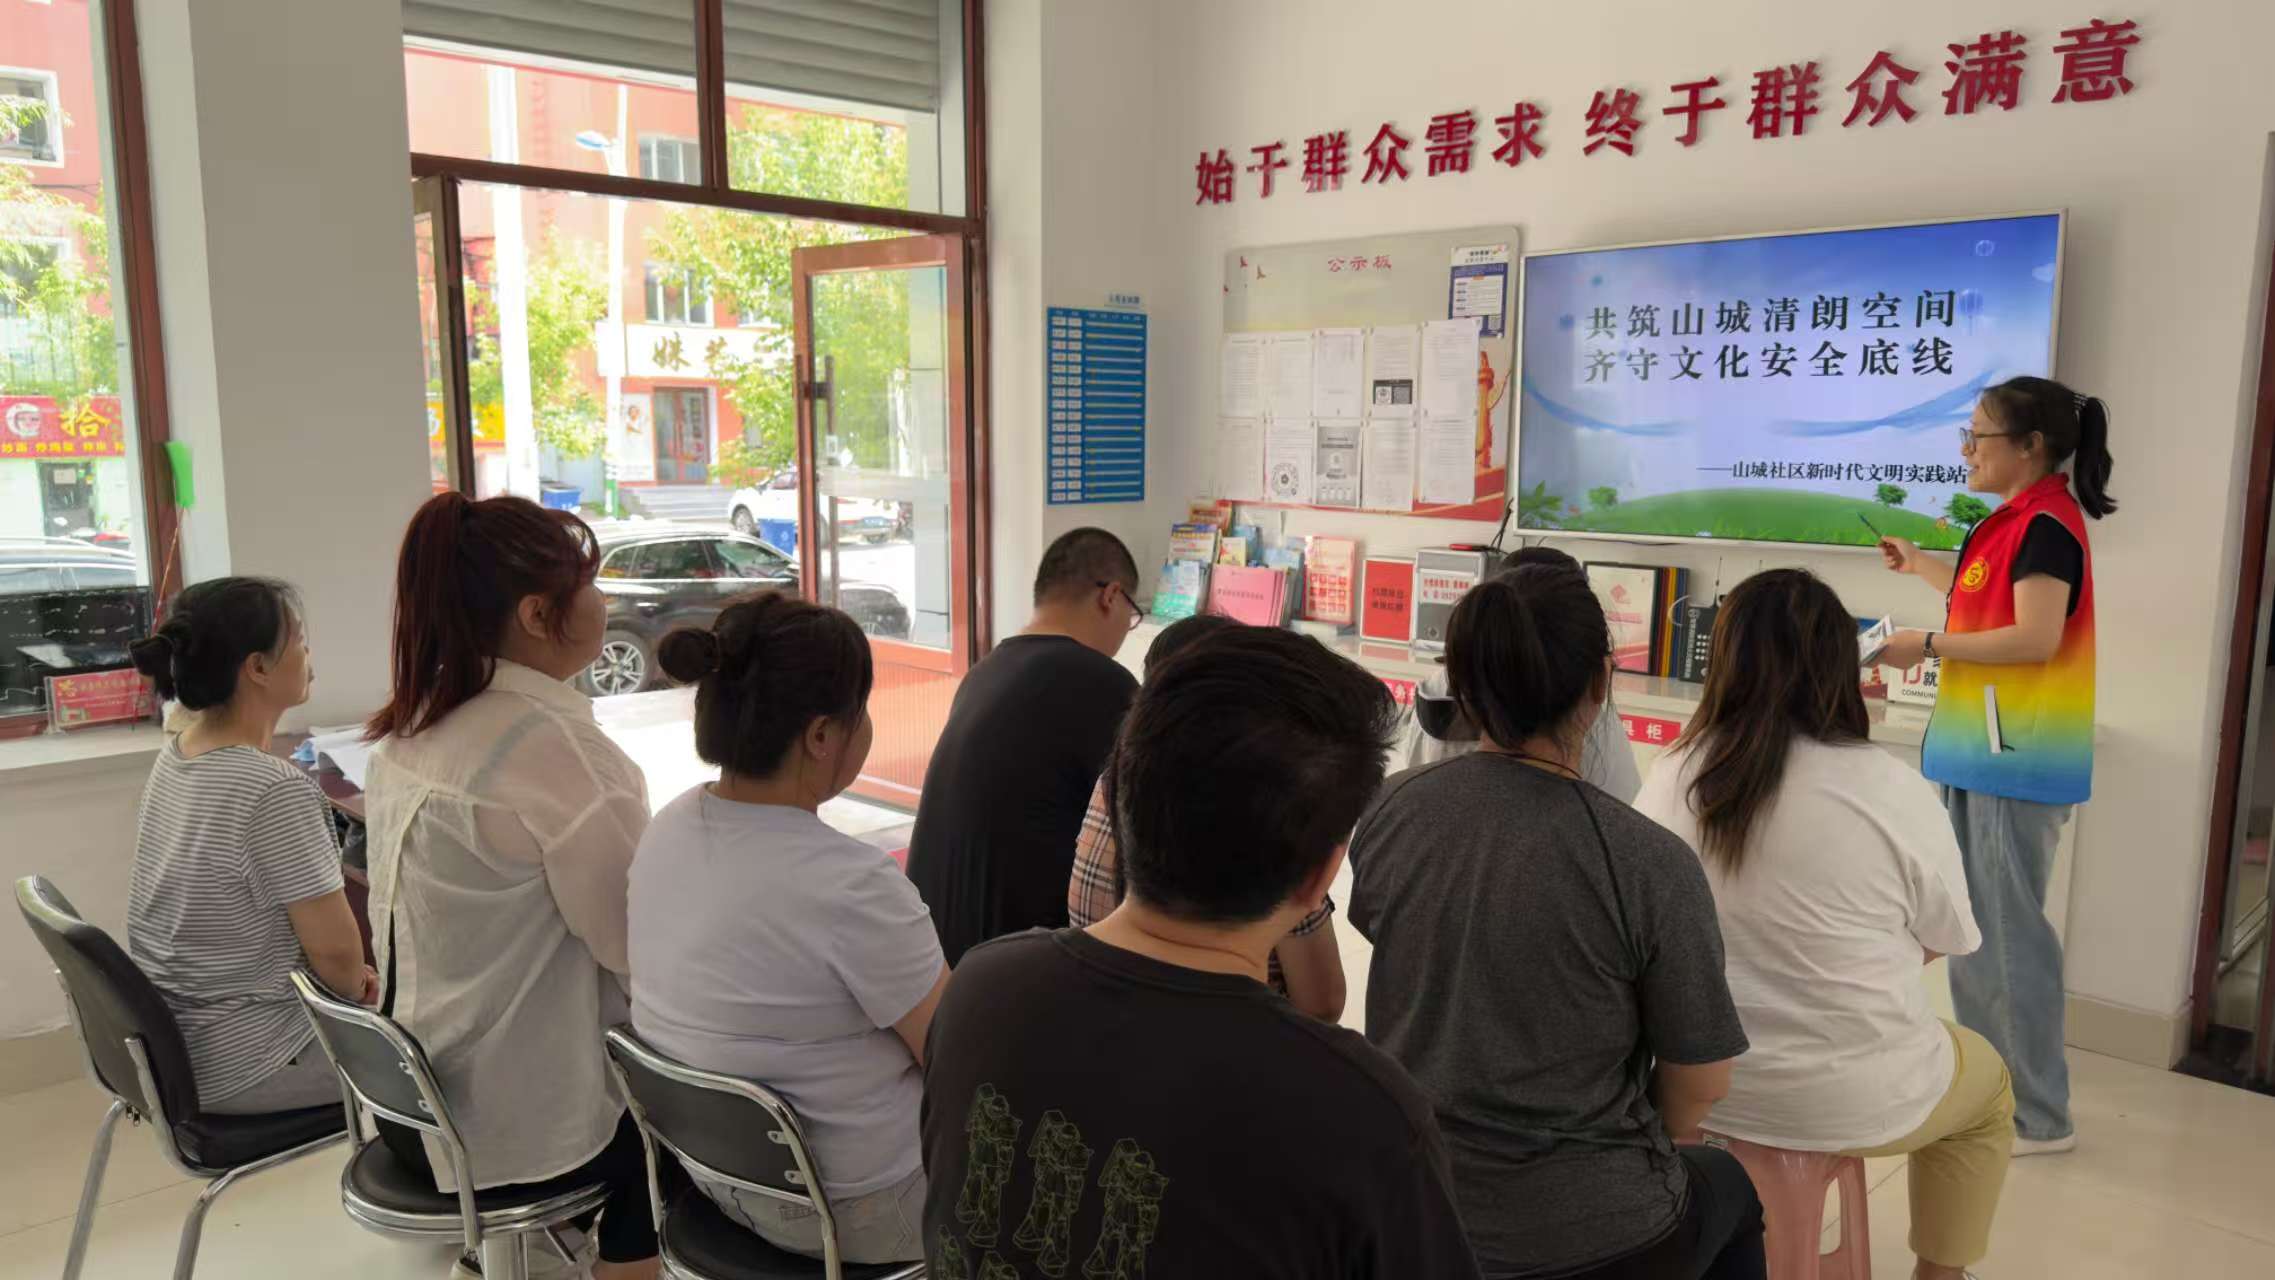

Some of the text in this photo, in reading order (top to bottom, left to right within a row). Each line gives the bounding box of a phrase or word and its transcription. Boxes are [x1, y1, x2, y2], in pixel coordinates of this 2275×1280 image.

[1195, 18, 2143, 206] 始于群众需求 终于群众满意
[1328, 255, 1392, 273] 公示板
[1585, 289, 1957, 341] 共筑山城清朗空间
[1584, 337, 1954, 384] 齐守文化安全底线
